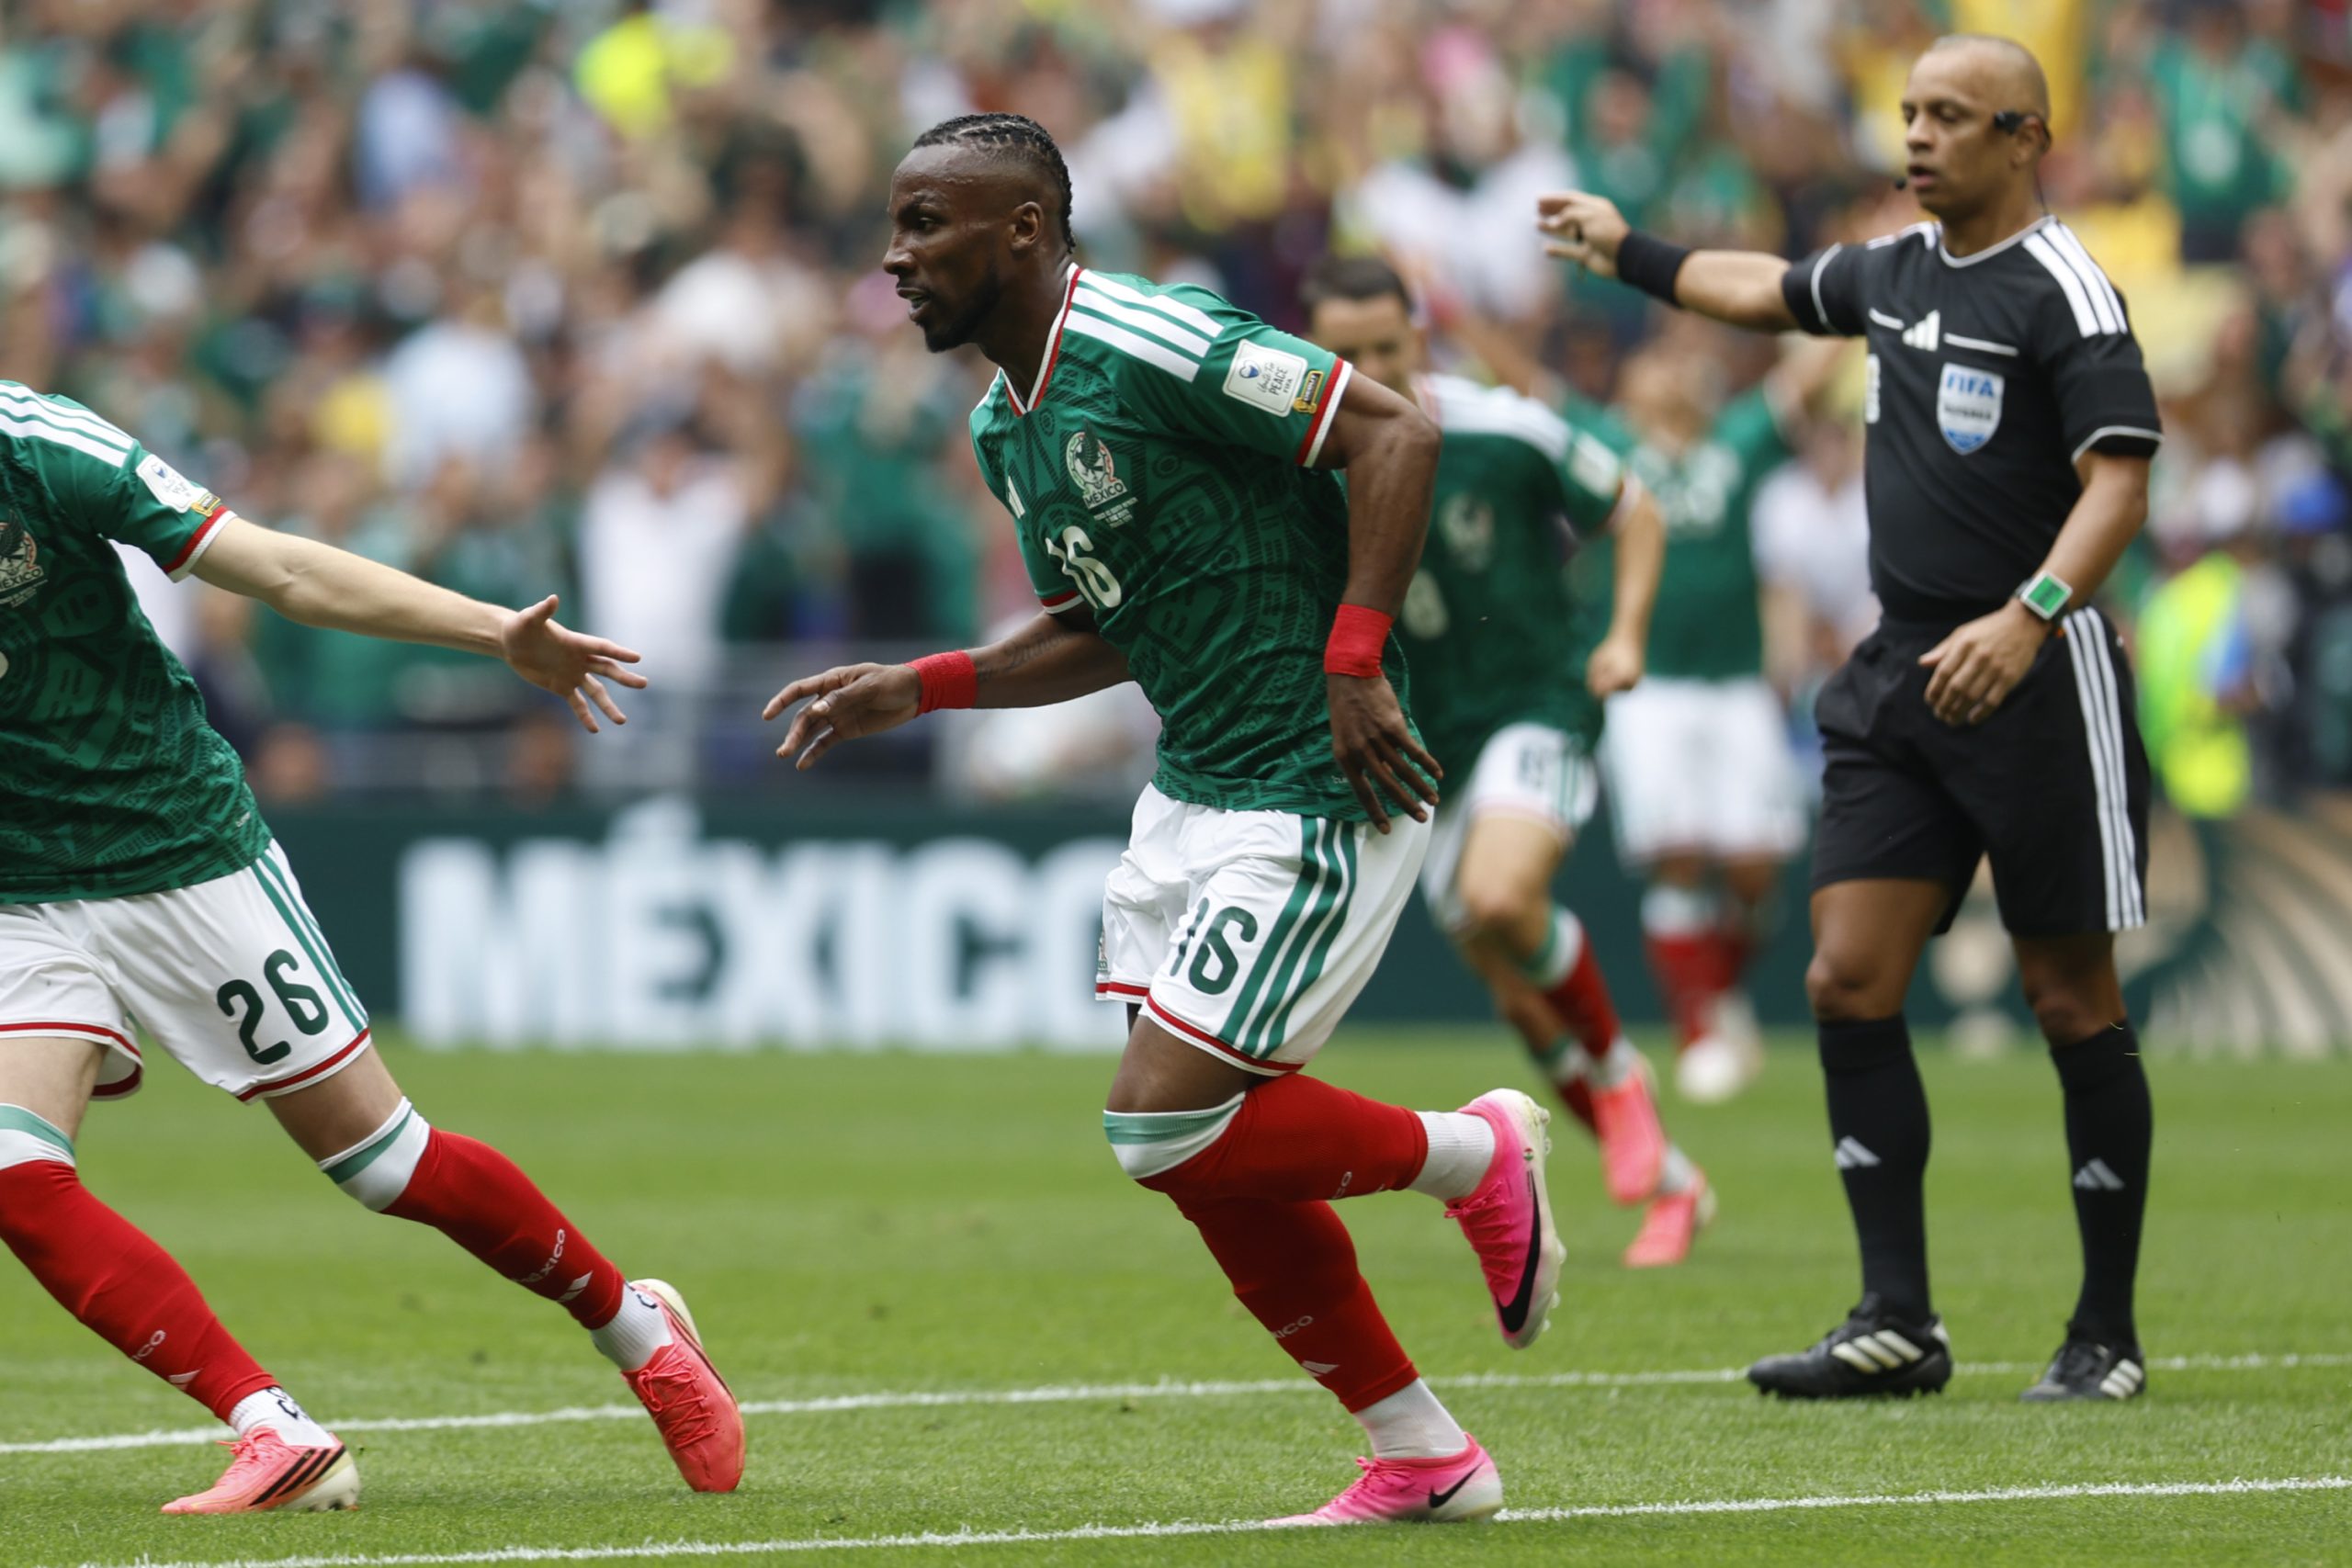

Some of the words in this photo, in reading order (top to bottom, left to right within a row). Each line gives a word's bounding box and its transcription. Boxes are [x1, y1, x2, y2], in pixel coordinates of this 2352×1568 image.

[1269, 367, 1288, 396] PEACE
[1946, 372, 1995, 398] FIFA
[1045, 525, 1122, 609] 16
[1170, 897, 1258, 995] 16
[217, 949, 329, 1065] 26
